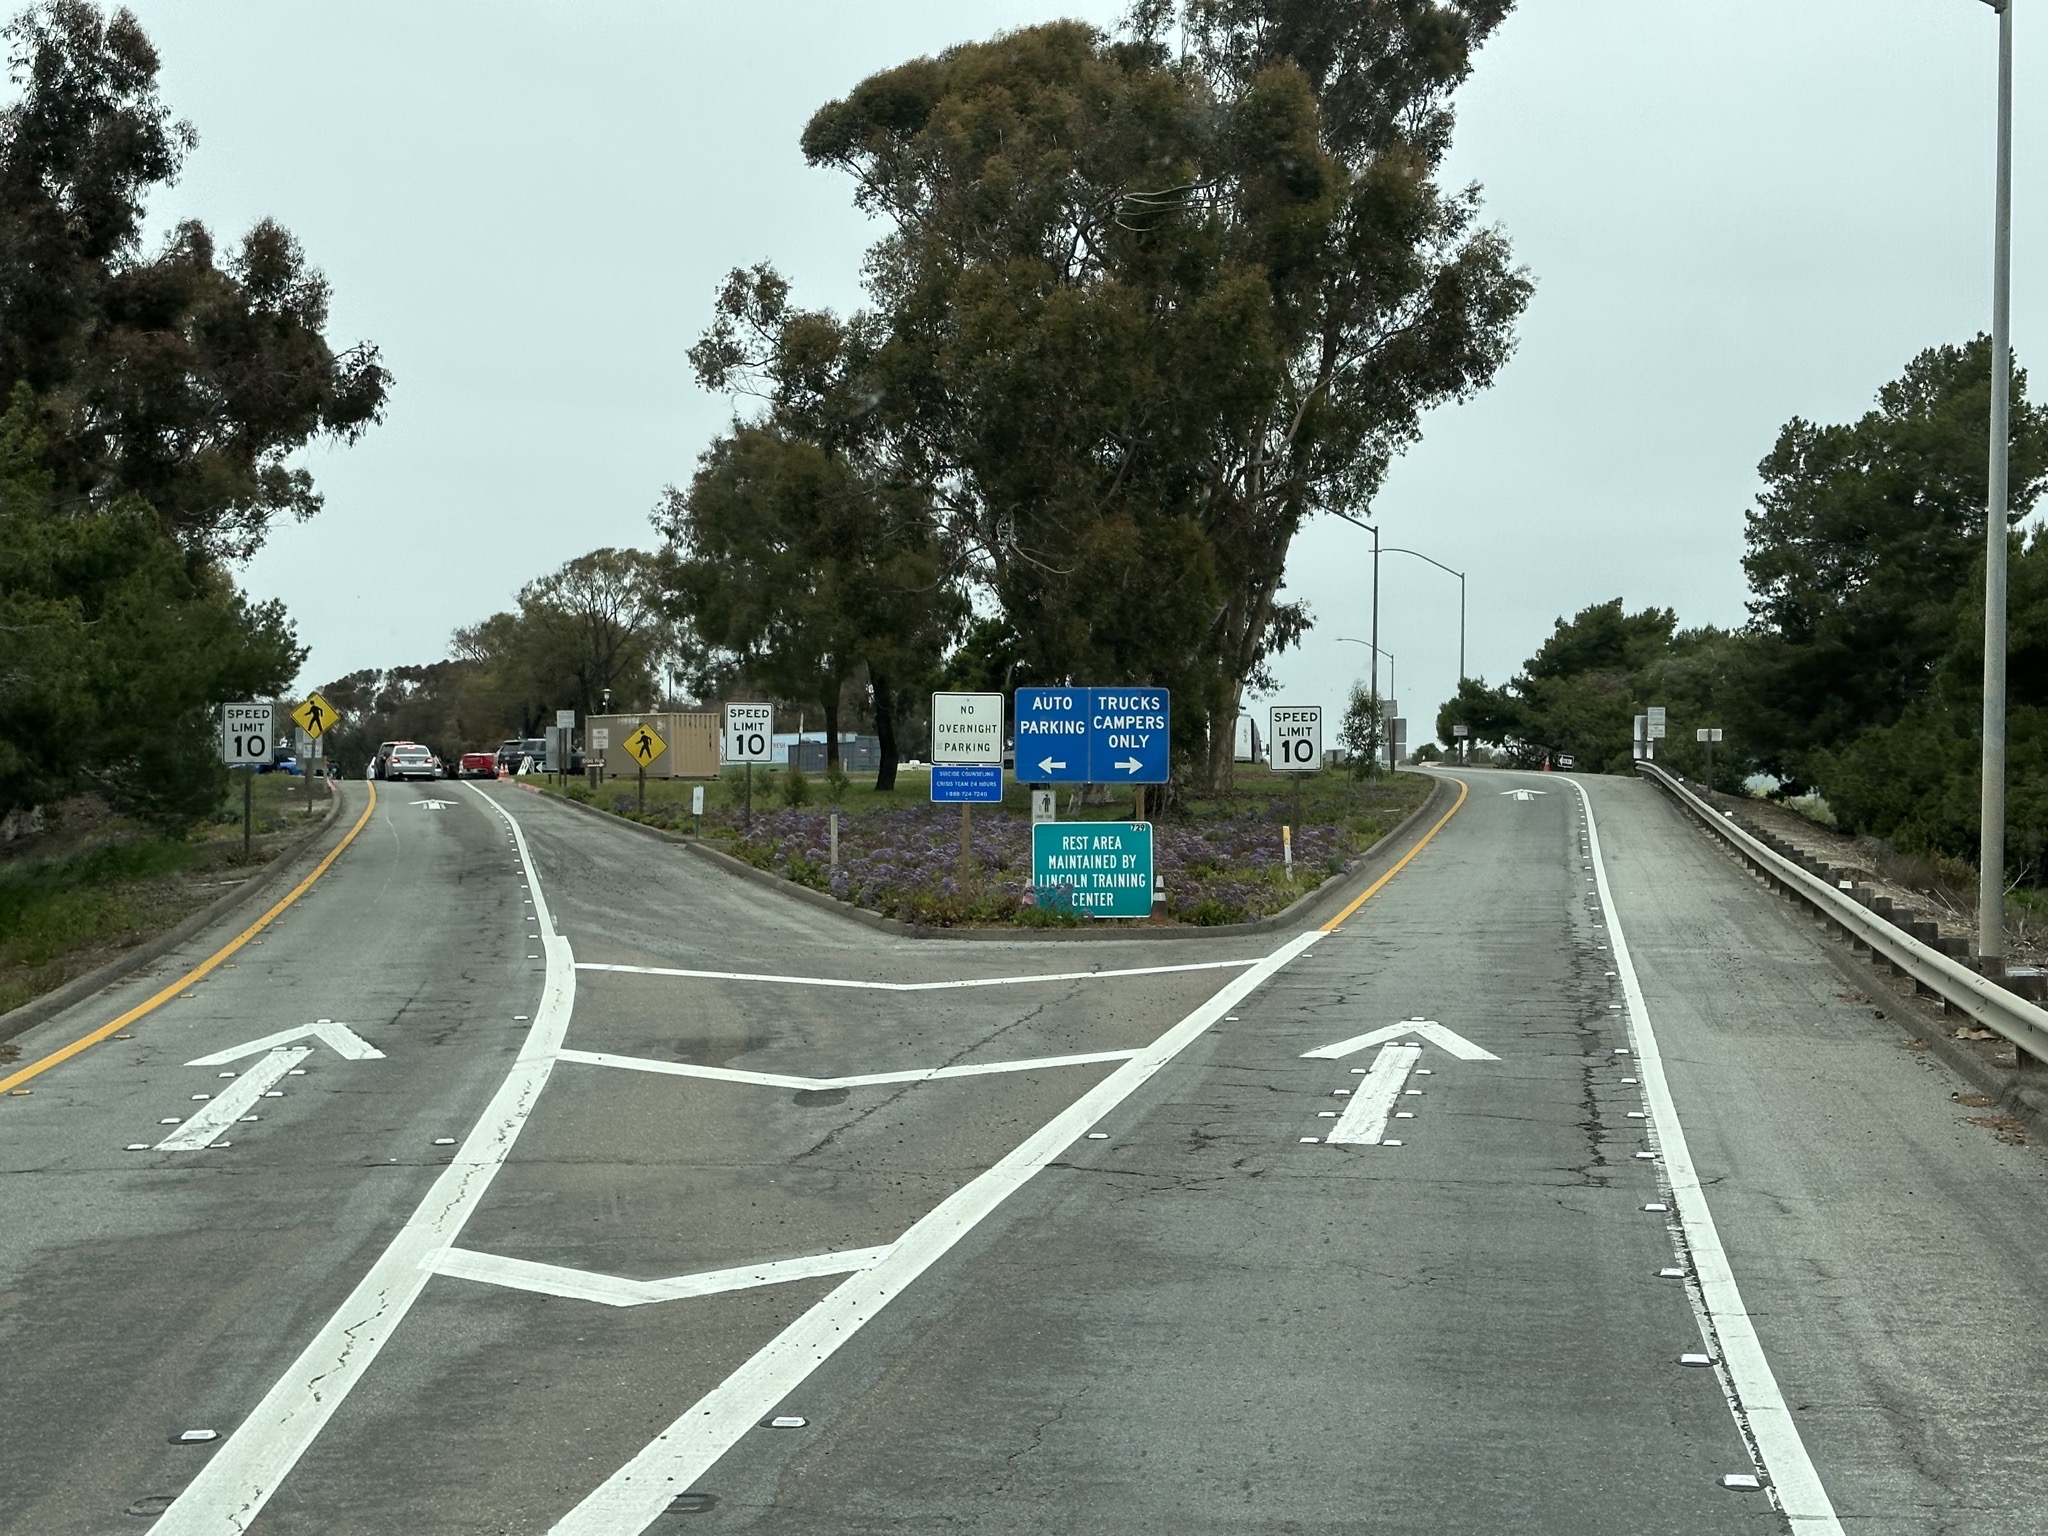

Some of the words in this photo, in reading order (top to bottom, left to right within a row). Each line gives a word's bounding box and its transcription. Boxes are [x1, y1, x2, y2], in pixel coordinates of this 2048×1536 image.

[960, 705, 974, 715] NO
[1032, 697, 1073, 710] AUTO
[1098, 697, 1160, 710] TRUCKS
[227, 709, 270, 719] SPEED
[729, 709, 770, 718] SPEED
[1274, 712, 1318, 722] SPEED
[231, 723, 265, 732] LIMIT
[733, 722, 765, 731] LIMIT
[939, 724, 997, 734] OVERNIGHT
[1020, 720, 1085, 735] PARKING
[1093, 716, 1165, 730] CAMPERS
[1278, 727, 1313, 737] LIMIT
[234, 735, 266, 757] 10
[736, 733, 765, 755] 10
[944, 742, 991, 752] PARKING
[1109, 735, 1150, 748] ONLY
[1282, 739, 1314, 763] 10
[1062, 836, 1089, 850] REST
[1092, 836, 1122, 850] AREA
[1048, 854, 1117, 869] MAINTAINED
[1122, 854, 1137, 869] BY
[1039, 874, 1088, 888] LINCOLN
[1092, 873, 1146, 888] TRAINING
[1071, 892, 1114, 907] CENTER
